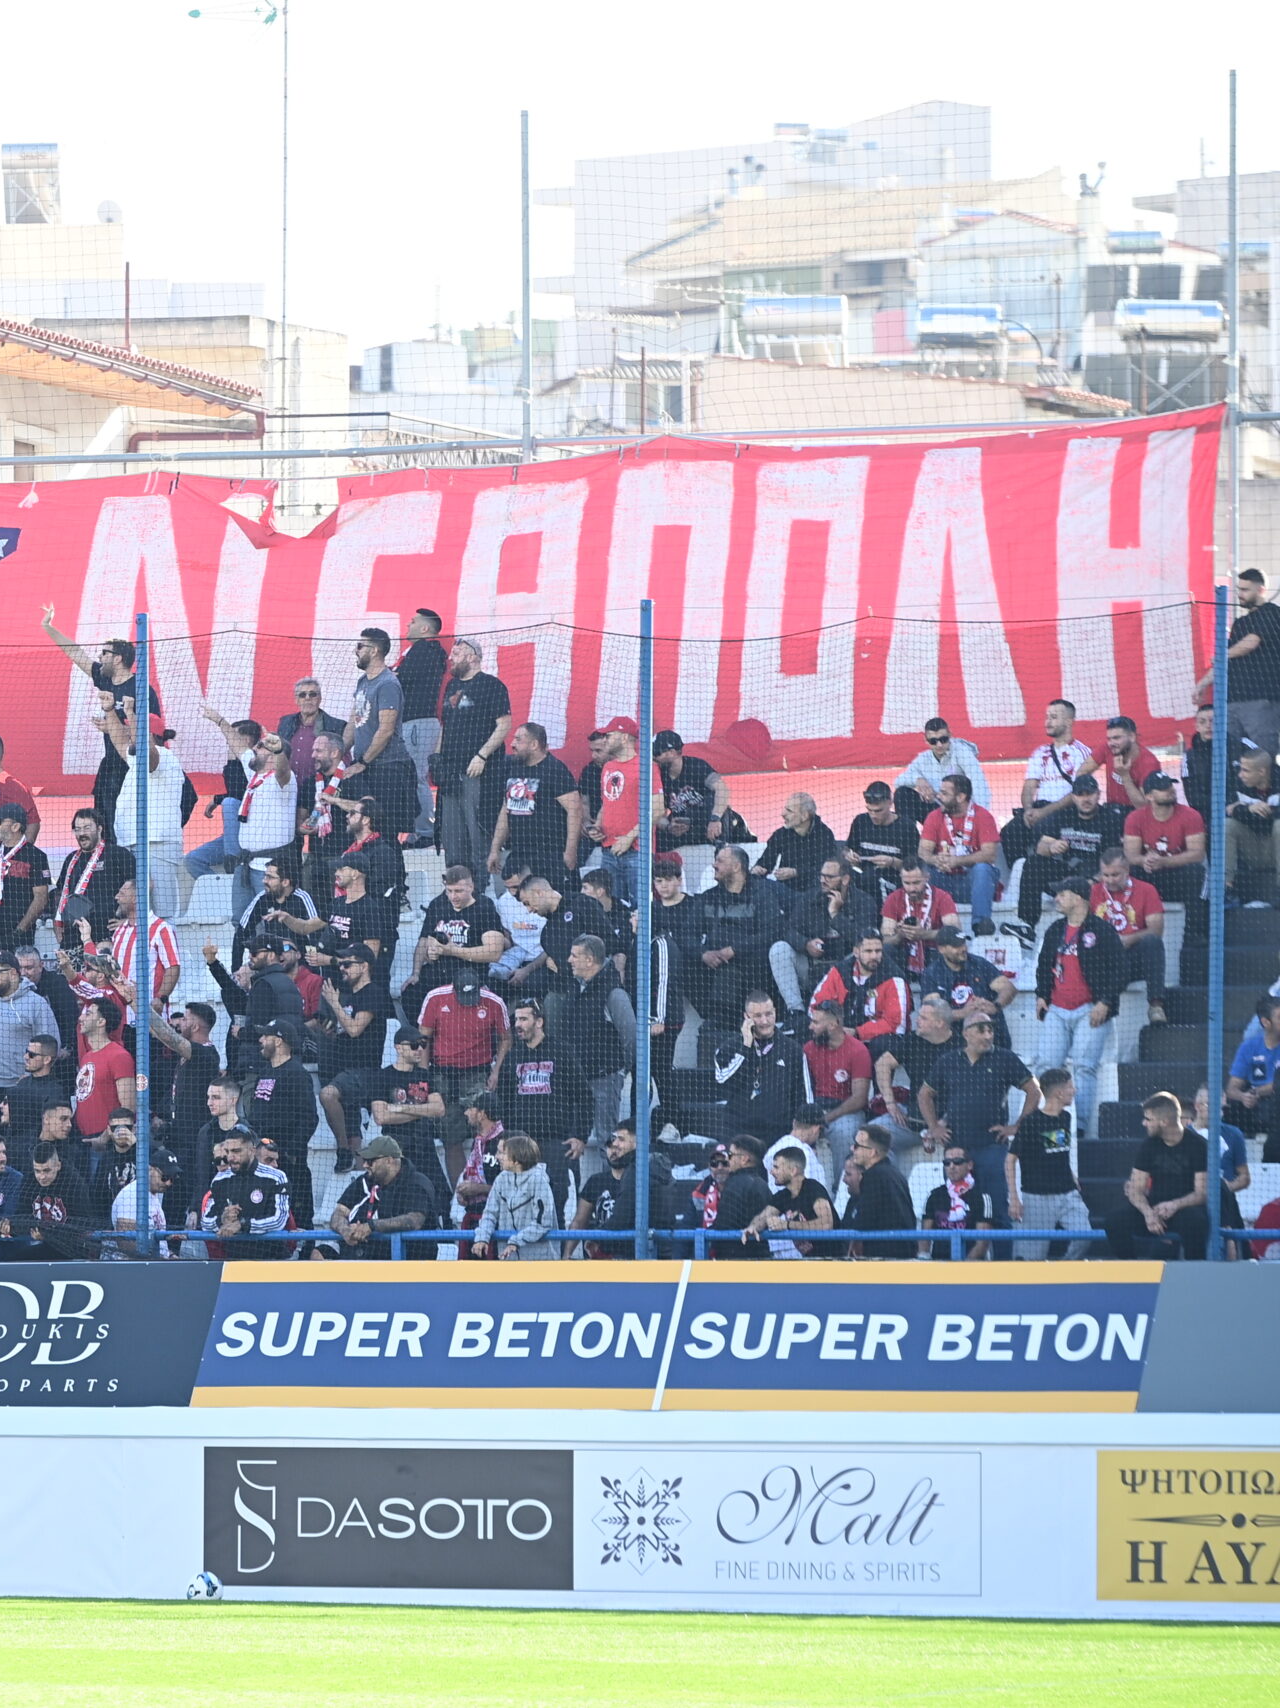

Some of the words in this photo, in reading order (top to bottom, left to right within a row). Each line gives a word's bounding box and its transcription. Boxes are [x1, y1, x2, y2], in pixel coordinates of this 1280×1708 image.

[215, 1311, 431, 1359] SUPER
[447, 1311, 662, 1359] BETON
[683, 1311, 909, 1361] SUPER
[927, 1312, 1149, 1362] BETON
[1118, 1468, 1280, 1496] ΨΗΤΟΠΩ
[296, 1497, 554, 1542] DASOTTO
[715, 1465, 945, 1547] Malt
[714, 1560, 760, 1580] FINE
[766, 1560, 837, 1582] DINING
[842, 1561, 856, 1582] &
[863, 1562, 942, 1583] SPIRITS
